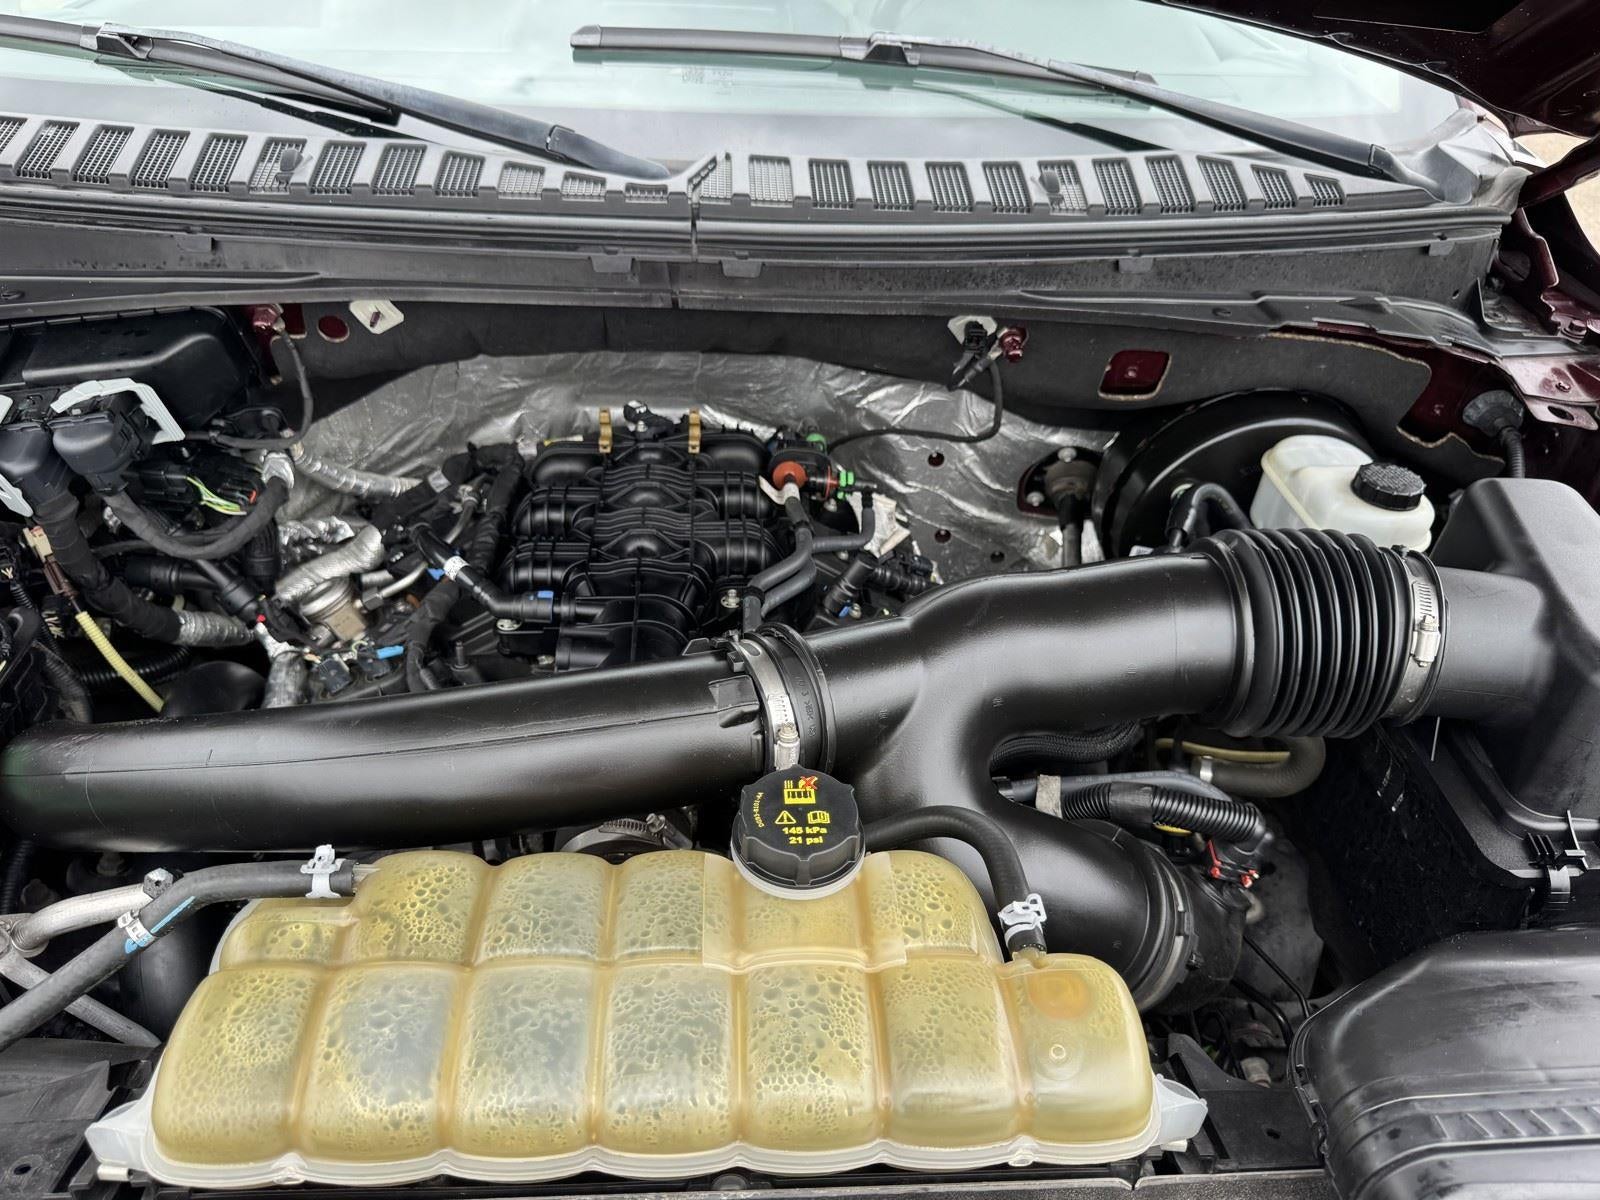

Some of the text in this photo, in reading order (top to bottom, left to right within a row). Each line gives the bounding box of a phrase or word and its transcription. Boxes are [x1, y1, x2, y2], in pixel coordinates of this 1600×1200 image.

[782, 826, 828, 835] 145 kPa
[788, 835, 824, 846] 21 psi
